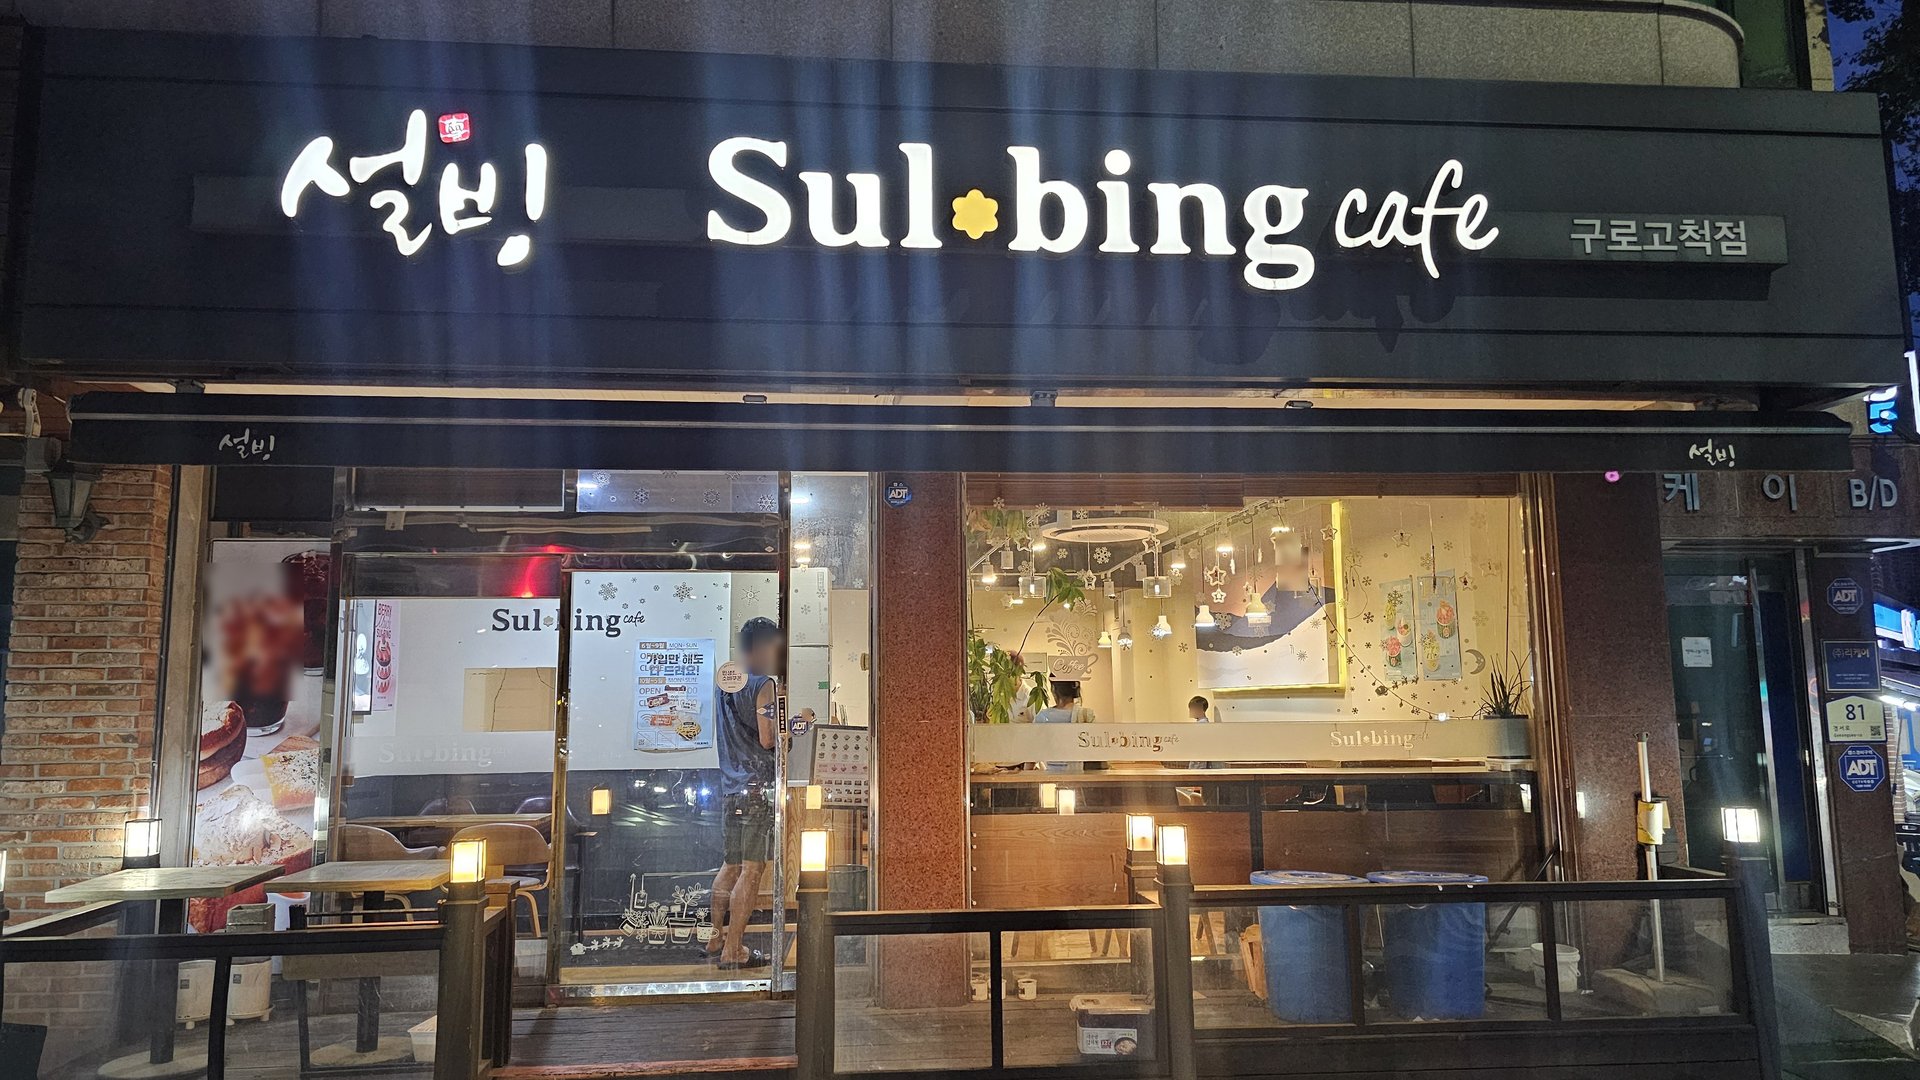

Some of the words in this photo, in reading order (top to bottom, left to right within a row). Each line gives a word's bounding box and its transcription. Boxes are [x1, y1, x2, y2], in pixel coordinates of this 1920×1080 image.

[281, 108, 547, 267] 설빙
[1334, 158, 1499, 280] cafe
[1570, 218, 1748, 256] 구로고척점
[218, 427, 276, 461] 설빙
[1688, 438, 1736, 468] 설빙
[888, 488, 908, 499] ADT
[1850, 474, 1898, 512] B/D
[1832, 589, 1857, 602] ADT
[623, 610, 646, 627] cafe
[682, 653, 704, 665] 해도
[1053, 658, 1086, 674] Coffee
[639, 687, 662, 695] OPEN
[1845, 703, 1866, 721] 81
[791, 721, 807, 730] ADT
[1847, 759, 1877, 776] ADT
